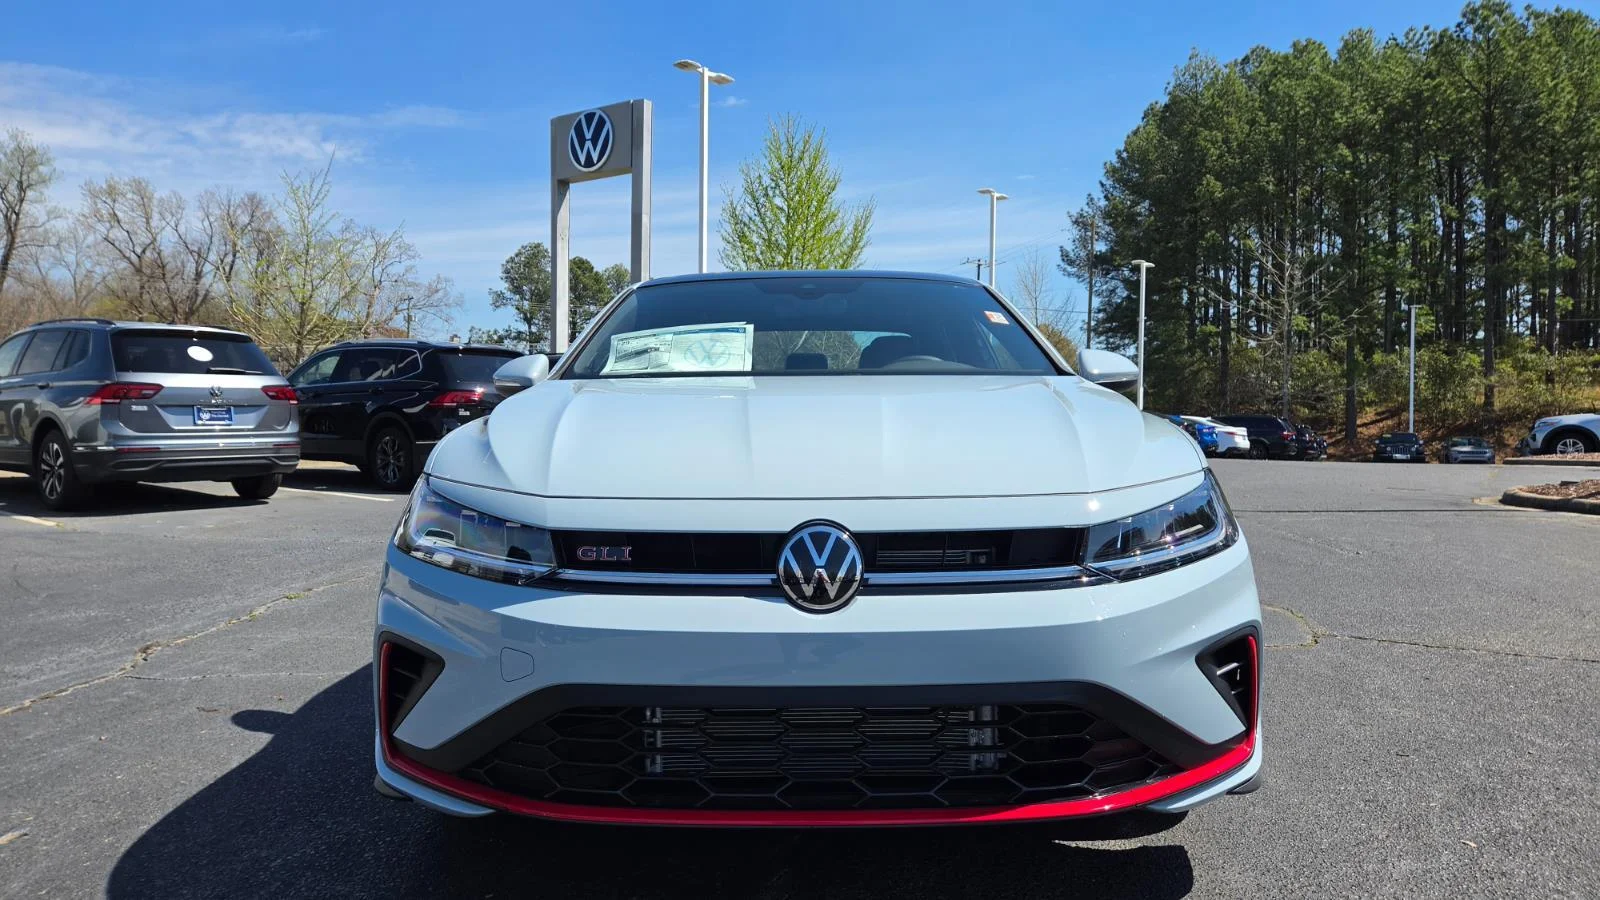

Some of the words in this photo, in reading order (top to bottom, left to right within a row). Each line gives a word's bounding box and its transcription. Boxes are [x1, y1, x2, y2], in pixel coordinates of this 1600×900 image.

[570, 109, 612, 168] VW
[576, 545, 633, 561] GLI
[783, 527, 858, 602] VW
